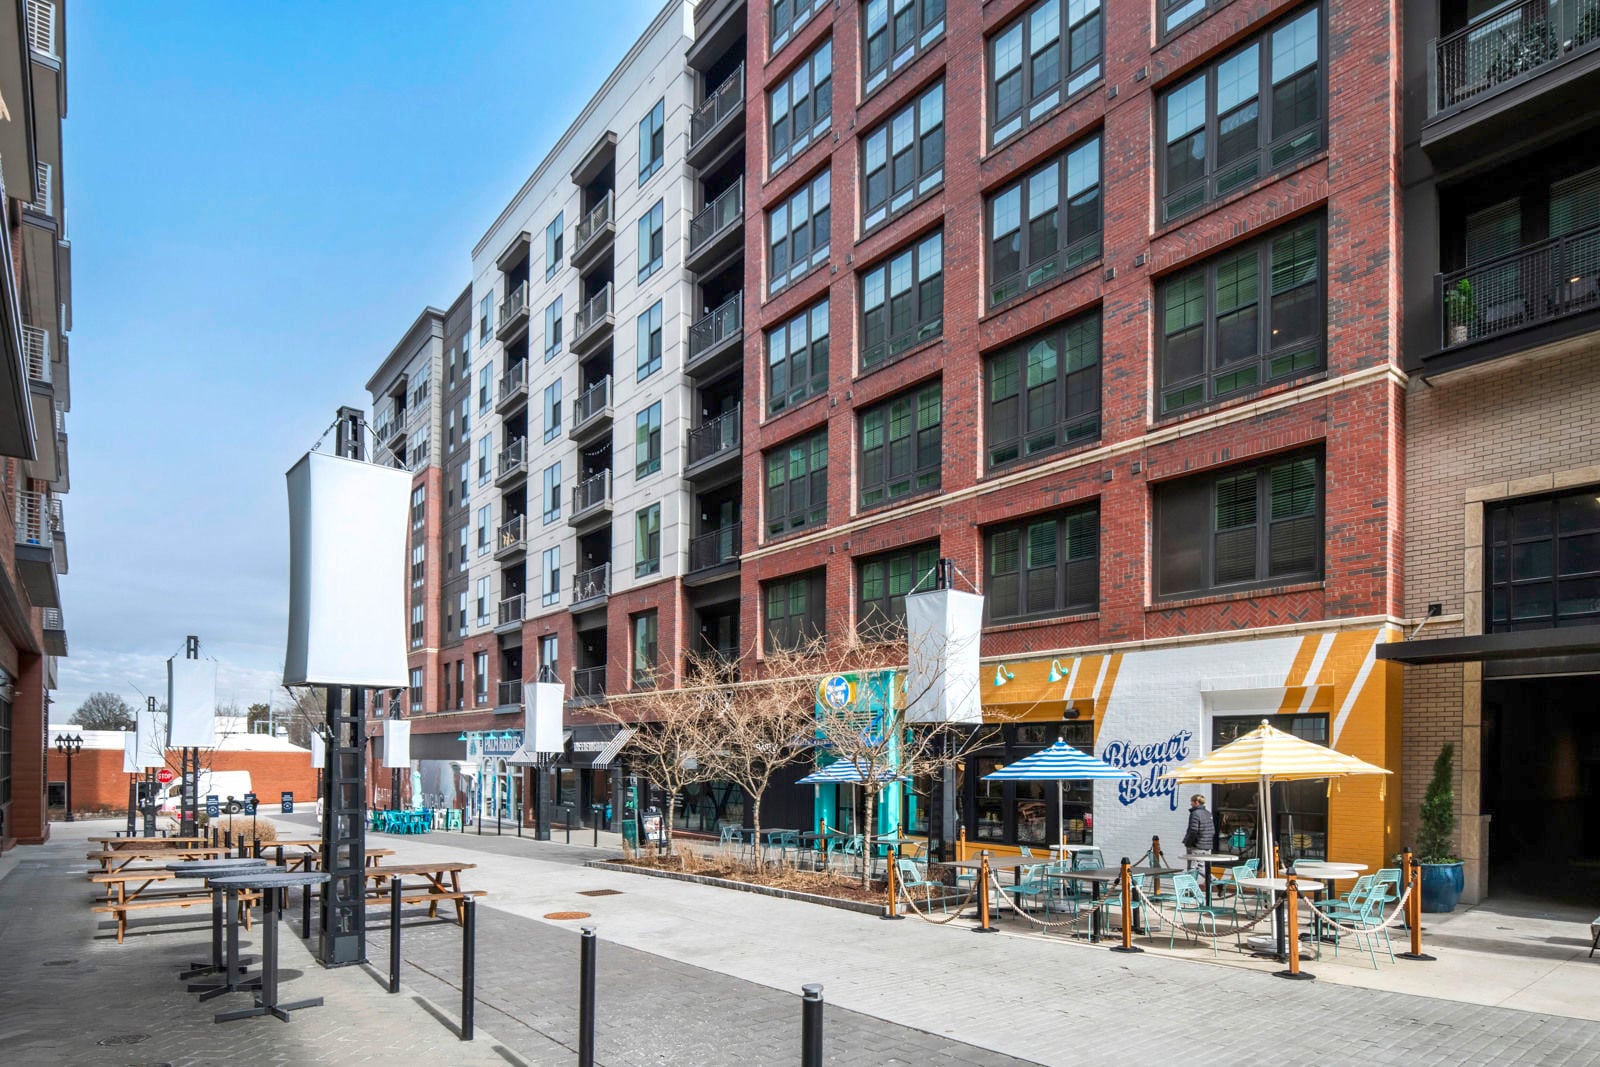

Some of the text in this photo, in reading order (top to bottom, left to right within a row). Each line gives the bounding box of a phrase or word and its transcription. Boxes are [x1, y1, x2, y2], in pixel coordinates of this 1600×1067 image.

[485, 735, 499, 752] PALM
[1102, 729, 1193, 769] Biscuit
[1118, 764, 1179, 812] Belly
